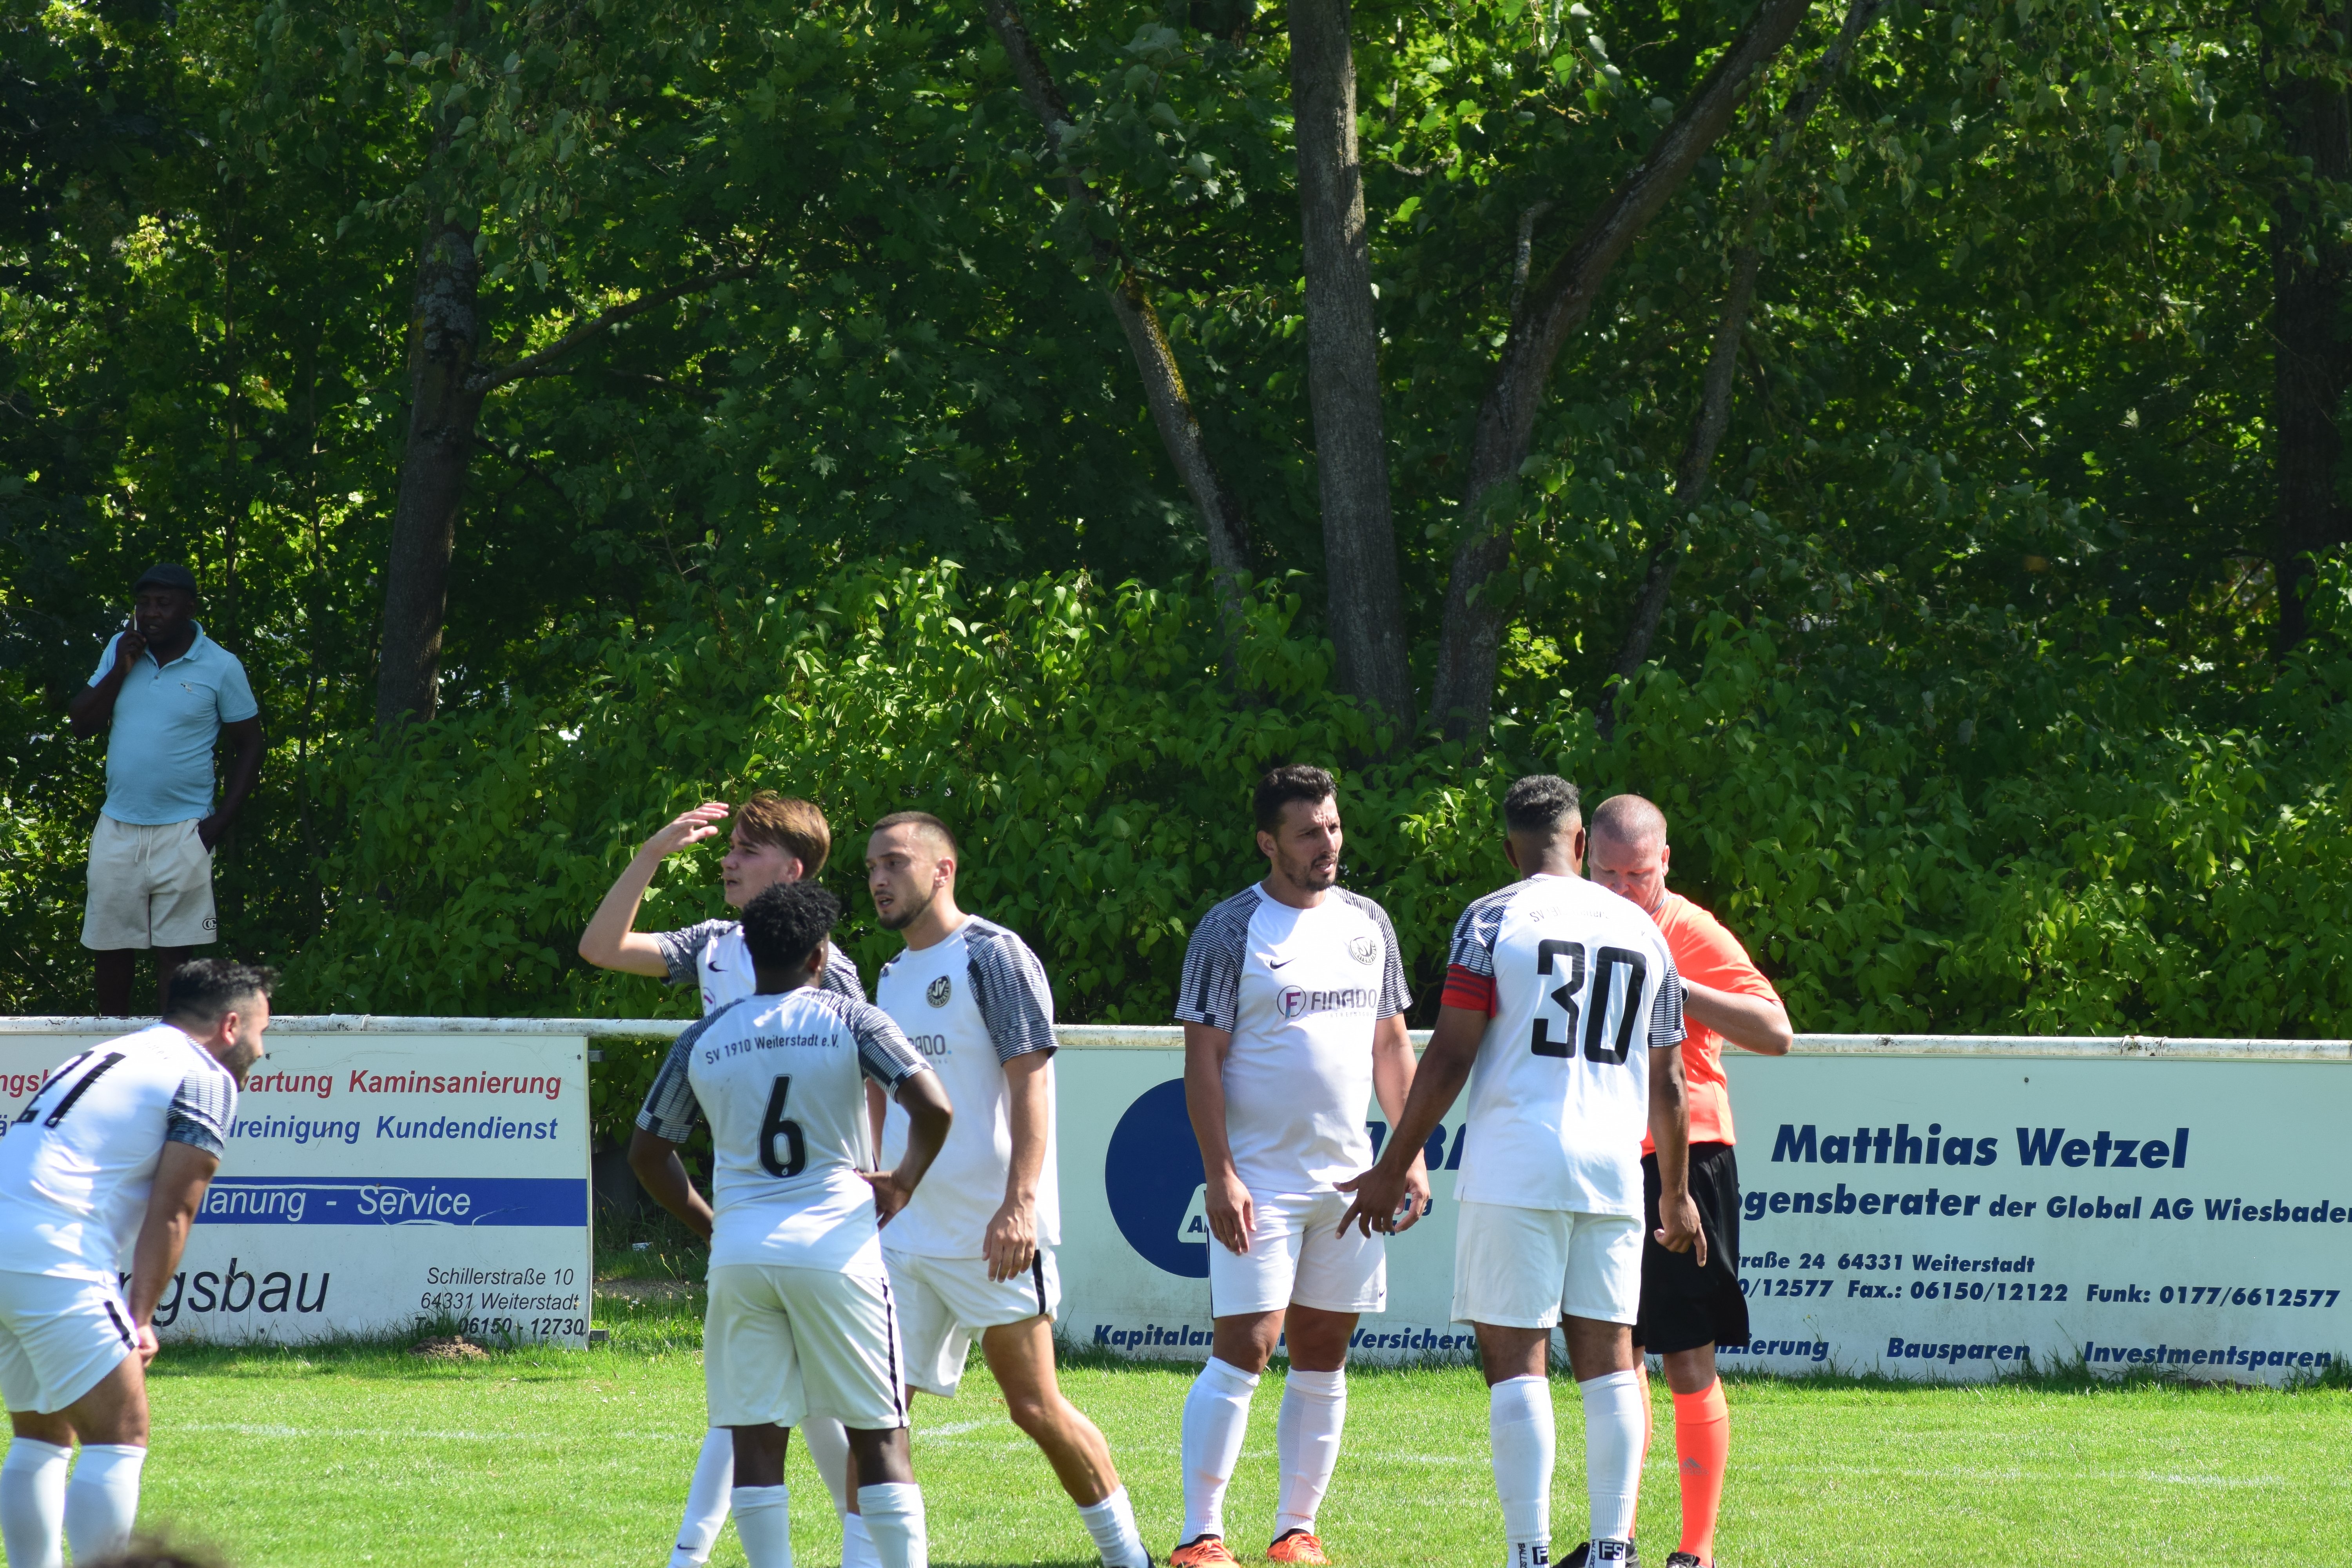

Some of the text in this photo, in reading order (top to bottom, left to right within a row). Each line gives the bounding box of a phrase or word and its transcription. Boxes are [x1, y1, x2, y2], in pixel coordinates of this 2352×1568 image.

[1531, 939, 1647, 1066] 30
[706, 1048, 720, 1064] SV
[724, 1039, 751, 1057] 1910
[755, 1034, 818, 1049] Weiterstadt
[349, 1070, 561, 1100] Kaminsanierung
[376, 1116, 558, 1140] Kundendienst
[758, 1074, 809, 1179] 6
[1771, 1123, 2189, 1169] Matthias Wetzel
[358, 1186, 470, 1215] Service
[1738, 1183, 1981, 1221] gensberater
[1989, 1194, 2036, 1217] der
[2046, 1195, 2142, 1219] Global
[2149, 1198, 2194, 1220] AG
[427, 1267, 573, 1285] Schillerstraße 10
[1798, 1253, 1825, 1269] 24
[1837, 1254, 1902, 1270] 64331
[1912, 1254, 2035, 1273] Weiterstadt
[421, 1292, 579, 1310] 64331 Weiterstadt
[1847, 1280, 1902, 1299] Fax.:
[1910, 1281, 2068, 1302] 06150/12122
[2086, 1284, 2151, 1303] Funk:
[2159, 1285, 2340, 1308] 0177/6612577
[531, 1318, 584, 1336] 12730
[1886, 1338, 2031, 1365] Bausparen
[2084, 1341, 2332, 1371] Investmentsparen
[1602, 1543, 1623, 1559] FS
